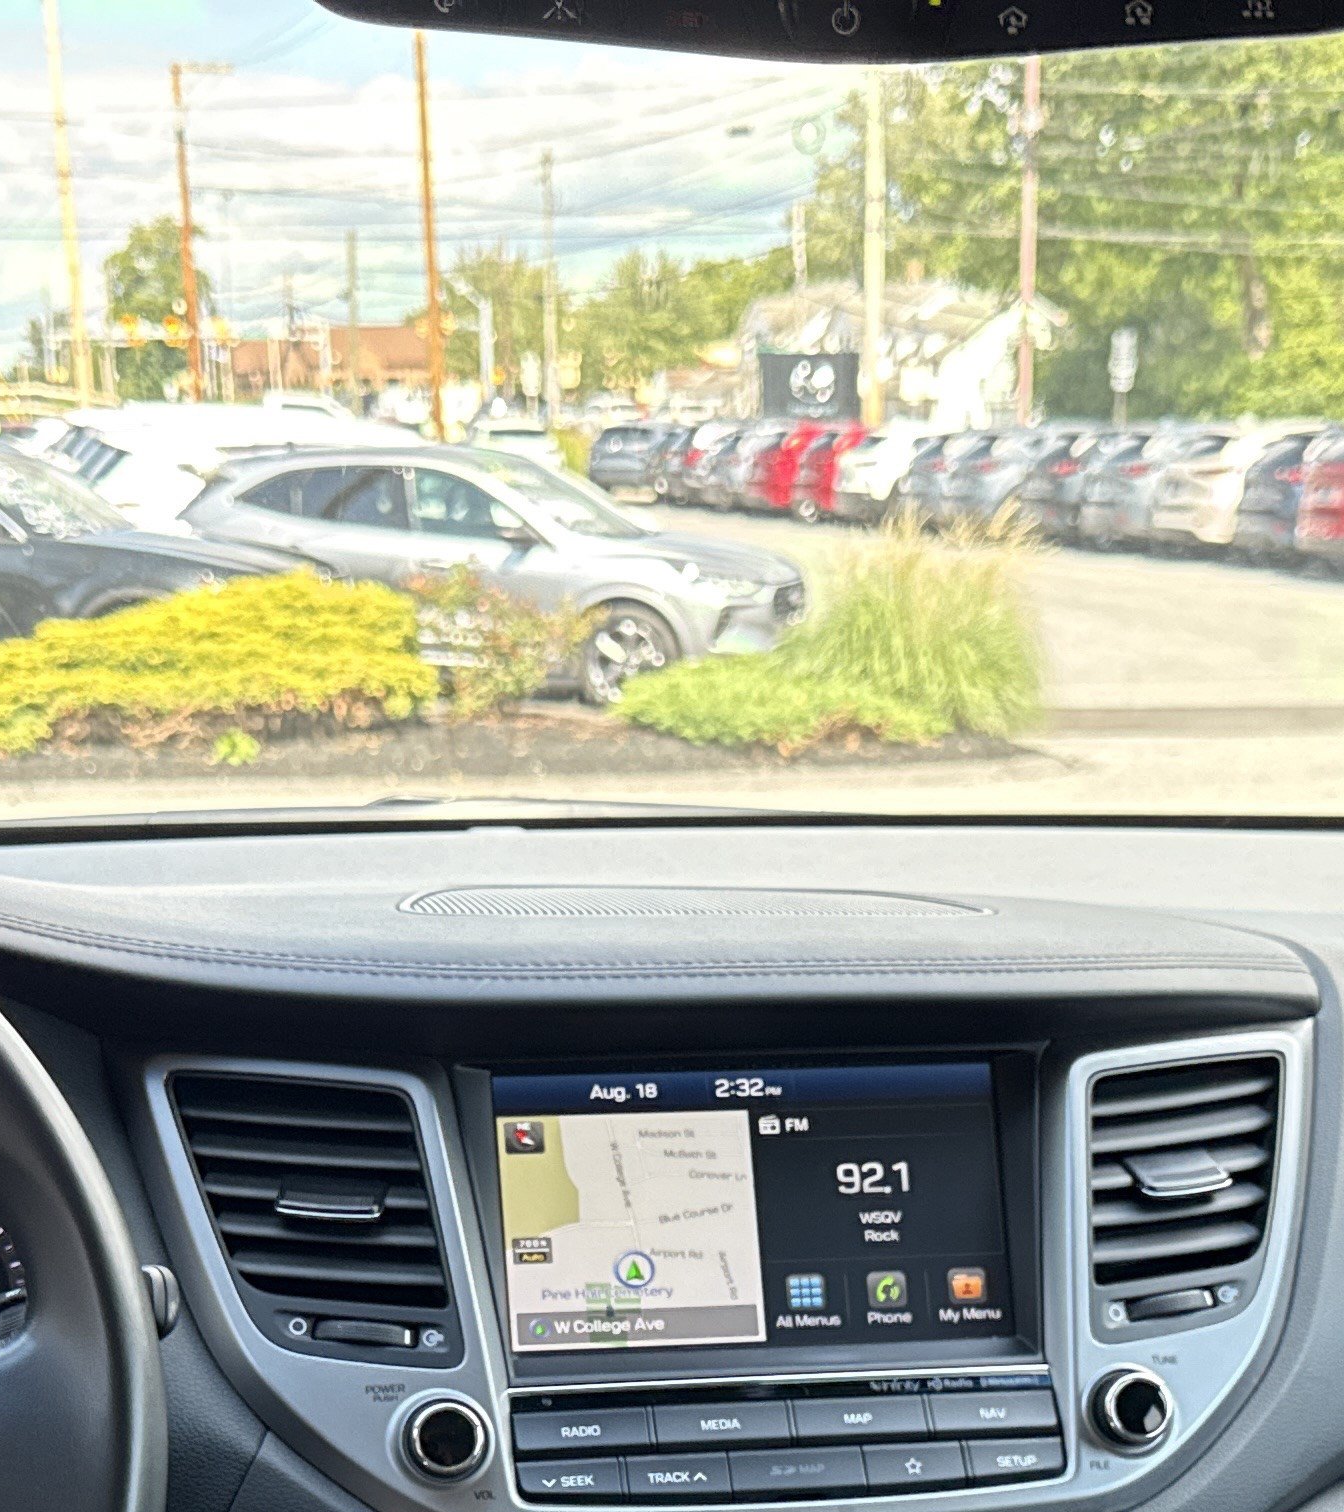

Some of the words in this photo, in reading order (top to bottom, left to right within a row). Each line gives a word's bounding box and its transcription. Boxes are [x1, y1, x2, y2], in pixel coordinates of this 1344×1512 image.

[589, 1084, 631, 1102] Aug.
[635, 1083, 658, 1098] 18
[785, 1117, 809, 1132] FM
[836, 1161, 911, 1195] 92.1
[864, 1229, 900, 1243] Rock
[542, 1288, 571, 1301] Pine
[776, 1315, 794, 1328] All
[796, 1314, 842, 1328] Menus
[867, 1312, 913, 1325] Phone
[939, 1308, 960, 1324] My
[962, 1307, 1002, 1321] Menu
[554, 1322, 570, 1334] W
[573, 1321, 631, 1336] College
[634, 1318, 666, 1331] Ave
[365, 1383, 406, 1394] POWER
[843, 1412, 874, 1425] MAP
[979, 1407, 1007, 1420] NAV
[560, 1424, 602, 1438] RADIO
[700, 1418, 742, 1431] MEDIA
[996, 1454, 1038, 1468] SETUP
[560, 1475, 595, 1488] SEEK
[647, 1471, 690, 1485] TRACK
[474, 1489, 495, 1500] VOL
